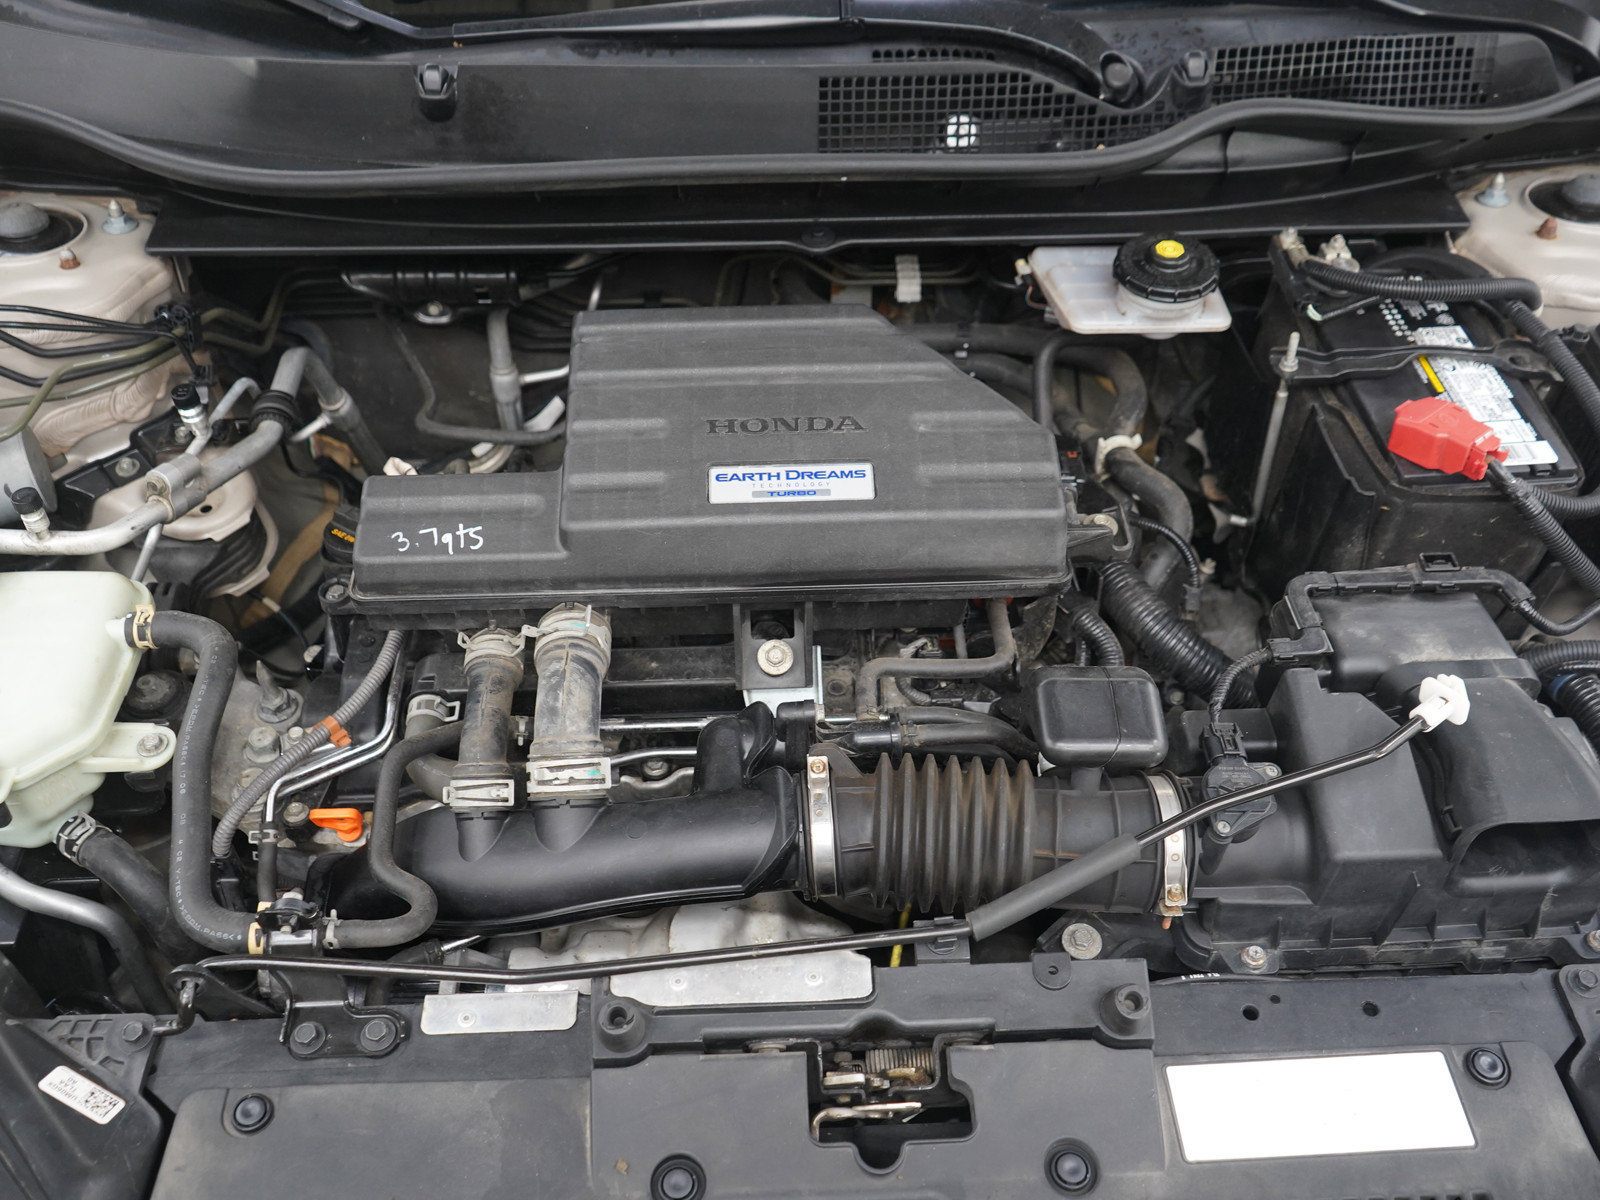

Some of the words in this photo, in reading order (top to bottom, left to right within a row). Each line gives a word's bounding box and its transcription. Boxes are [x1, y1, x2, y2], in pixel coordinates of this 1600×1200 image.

[706, 416, 868, 434] HONDA
[715, 472, 781, 482] EARTH
[785, 469, 867, 481] DREAMS
[752, 481, 831, 489] TECHNOLOGY
